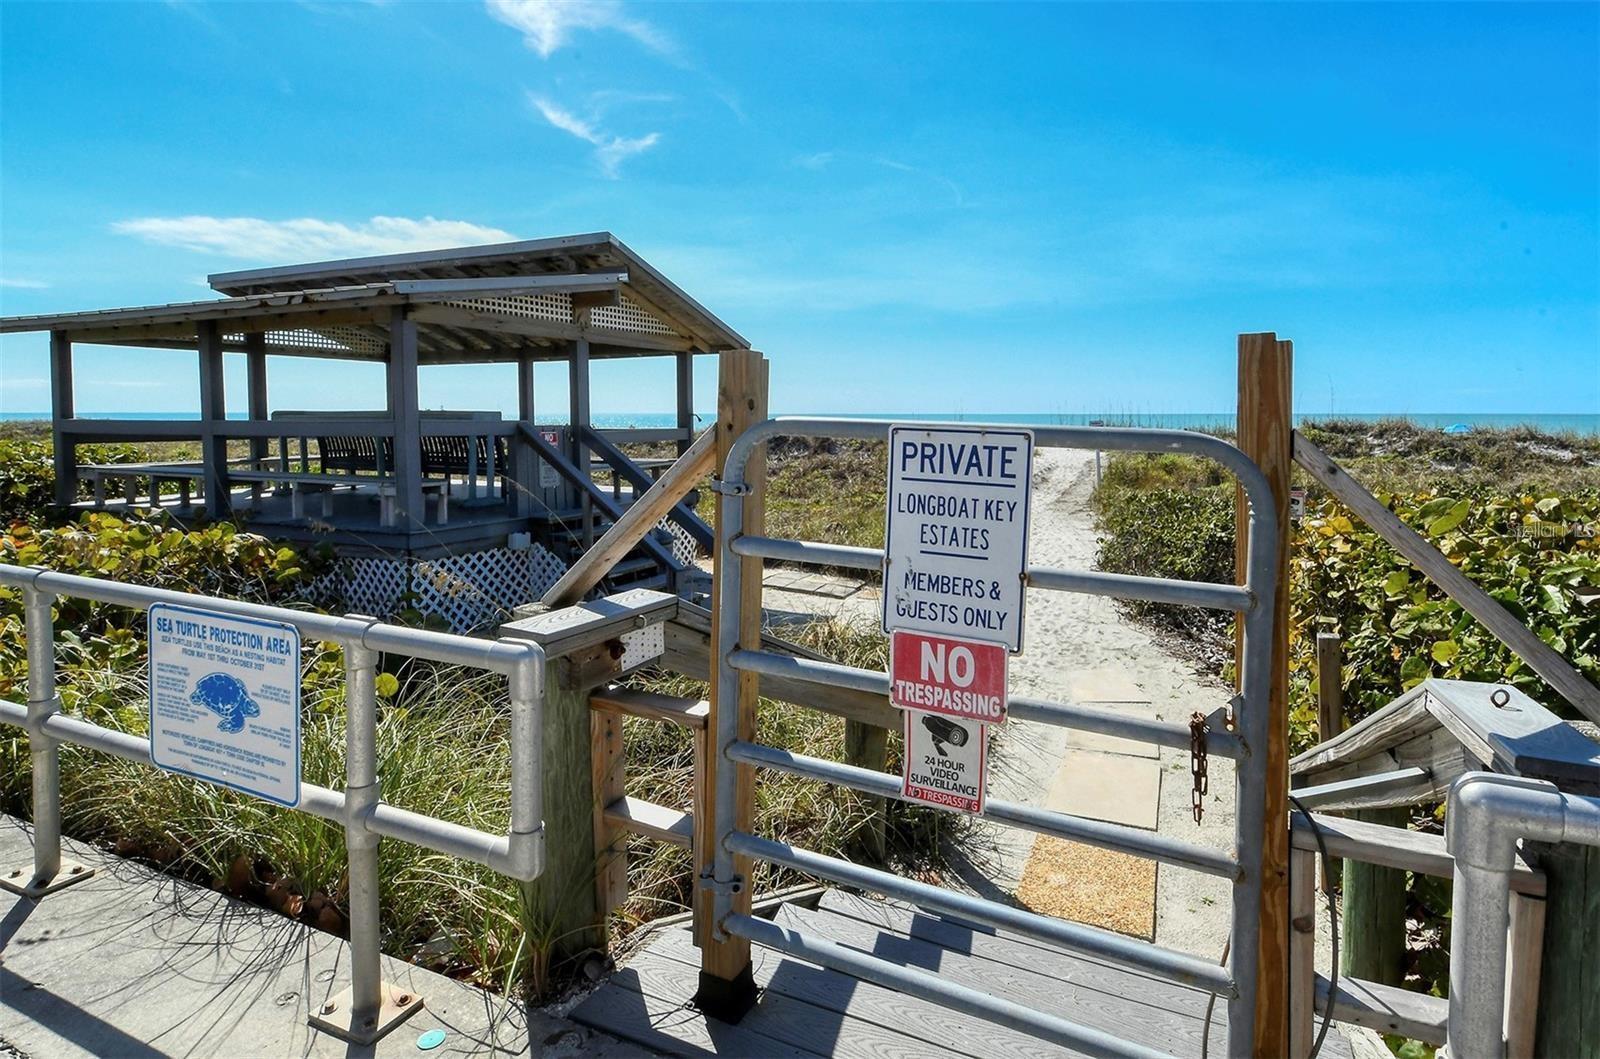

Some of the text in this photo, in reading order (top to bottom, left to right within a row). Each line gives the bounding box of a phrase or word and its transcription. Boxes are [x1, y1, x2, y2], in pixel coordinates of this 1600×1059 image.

[545, 433, 553, 442] NO
[901, 441, 1017, 479] PRIVATE
[898, 493, 1017, 522] LONGBOAT KEY
[920, 523, 990, 550] ESTATES
[904, 572, 1001, 600] MEMBERS &
[896, 600, 1008, 631] GUESTS ONLY
[156, 617, 291, 656] SEA TURTLE PROTECTION AREA
[161, 635, 171, 643] SEA
[920, 641, 975, 688] NO
[896, 679, 1000, 719] TRESPASSING
[924, 755, 965, 773] 24 HOUR
[930, 766, 959, 782] VIDEO
[907, 786, 922, 797] NO
[910, 773, 977, 797] SURVEILLANCE
